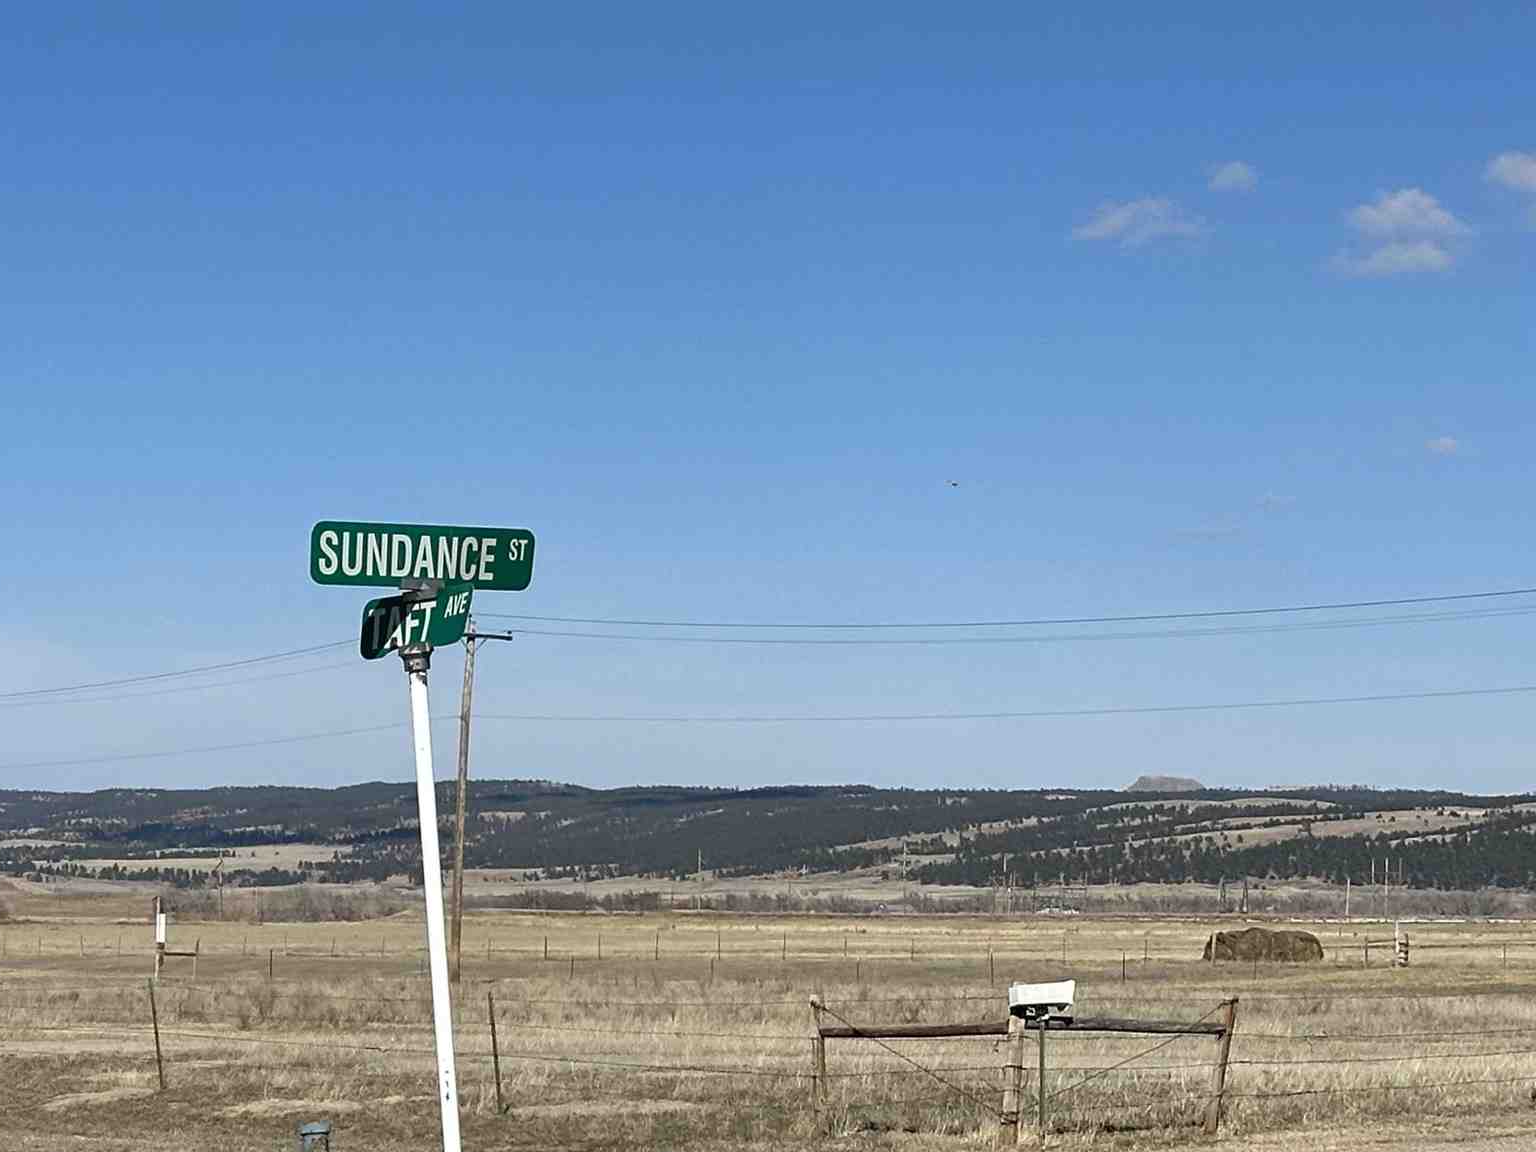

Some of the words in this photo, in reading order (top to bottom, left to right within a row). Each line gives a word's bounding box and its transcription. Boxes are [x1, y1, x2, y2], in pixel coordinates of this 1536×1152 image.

[318, 530, 497, 581] SUNDANCE
[508, 539, 529, 561] ST
[367, 600, 437, 650] TAFT
[444, 591, 469, 619] AVE
